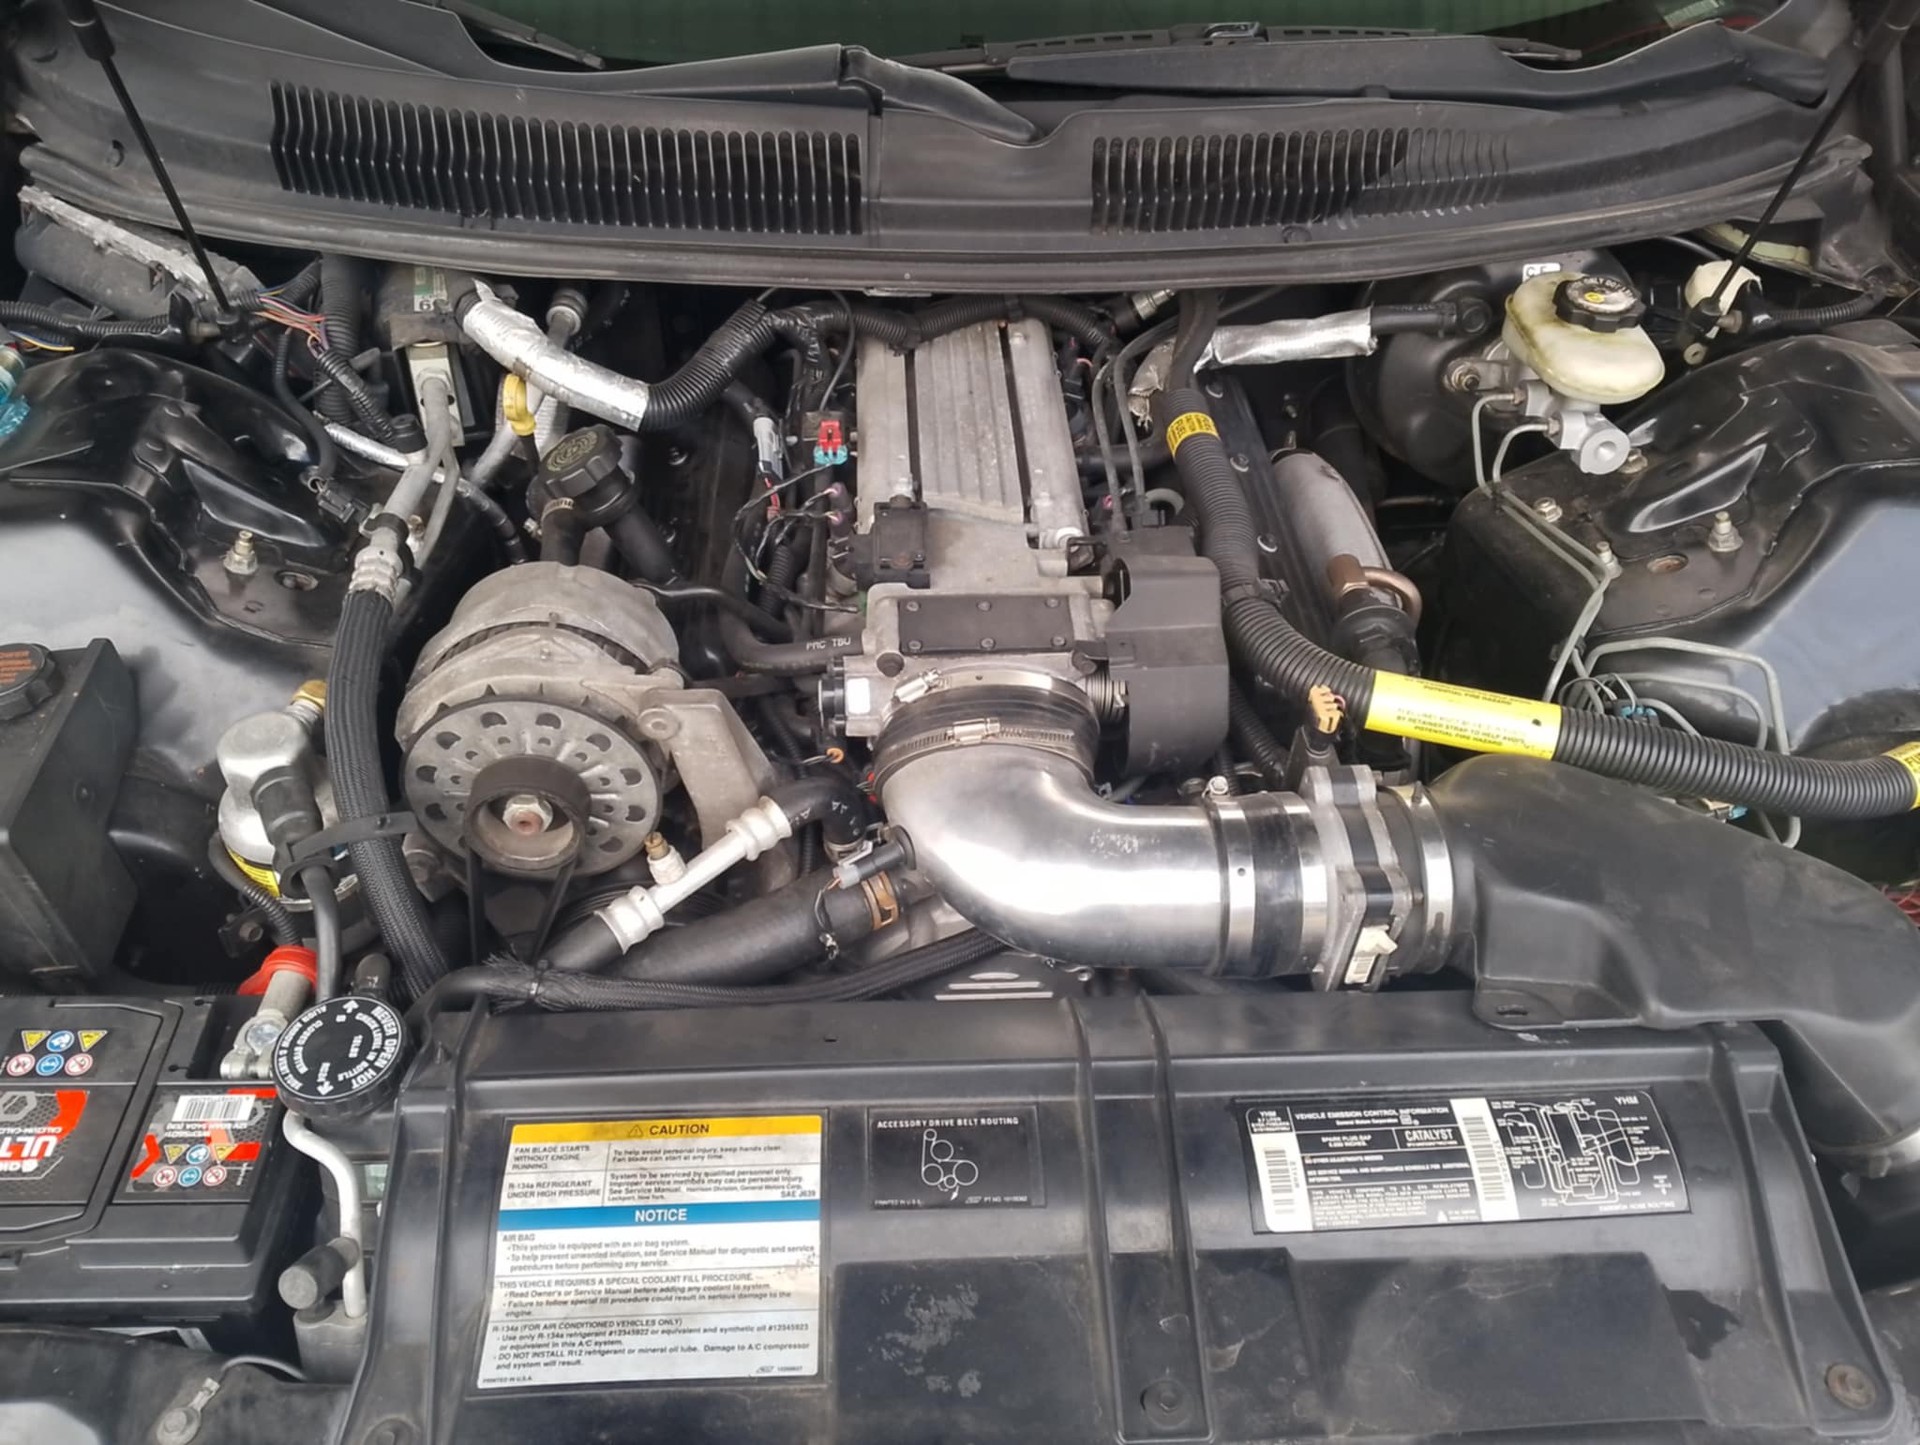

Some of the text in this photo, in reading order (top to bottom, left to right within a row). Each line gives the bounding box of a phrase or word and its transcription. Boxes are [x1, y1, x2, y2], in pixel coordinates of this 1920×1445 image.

[301, 1005, 328, 1024] ALIGN
[370, 1005, 397, 1036] NEVER
[296, 1019, 324, 1046] CLOSED
[374, 1038, 398, 1069] OPEN
[337, 1060, 370, 1082] BOTTLE
[351, 1068, 377, 1090] HOT
[1615, 1096, 1639, 1105] YHM
[1295, 1111, 1326, 1120] VEHICLE
[1328, 1110, 1362, 1119] EMISSION
[1363, 1109, 1398, 1117] CONTROL
[649, 1124, 709, 1135] CAUTION
[877, 1117, 1019, 1129] ACCESSORY DRIVE BELT ROUTING
[1404, 1128, 1453, 1141] CATALYST
[633, 1208, 687, 1223] NOTICE
[521, 1253, 539, 1261] help
[539, 1252, 569, 1260] prevent
[570, 1251, 608, 1259] unwanted
[659, 1248, 687, 1256] Service
[688, 1247, 716, 1255] Manual
[730, 1245, 769, 1254] diagnostic
[787, 1244, 814, 1252] service
[566, 1242, 602, 1250] equipped
[553, 1278, 596, 1286] REQUIRES
[641, 1275, 680, 1283] COOLANT
[659, 1285, 685, 1293] adding
[702, 1283, 731, 1291] coolant
[742, 1282, 770, 1290] system
[557, 1321, 614, 1329] CONDITIONED
[615, 1319, 656, 1327] VEHICLES
[565, 1330, 606, 1338] refrigerant
[660, 1327, 701, 1335] equivalent
[719, 1325, 754, 1333] synthetic
[584, 1348, 625, 1356] refrigerant
[703, 1344, 735, 1352] Damage
[762, 1342, 809, 1350] compressor
[512, 1360, 541, 1369] system
